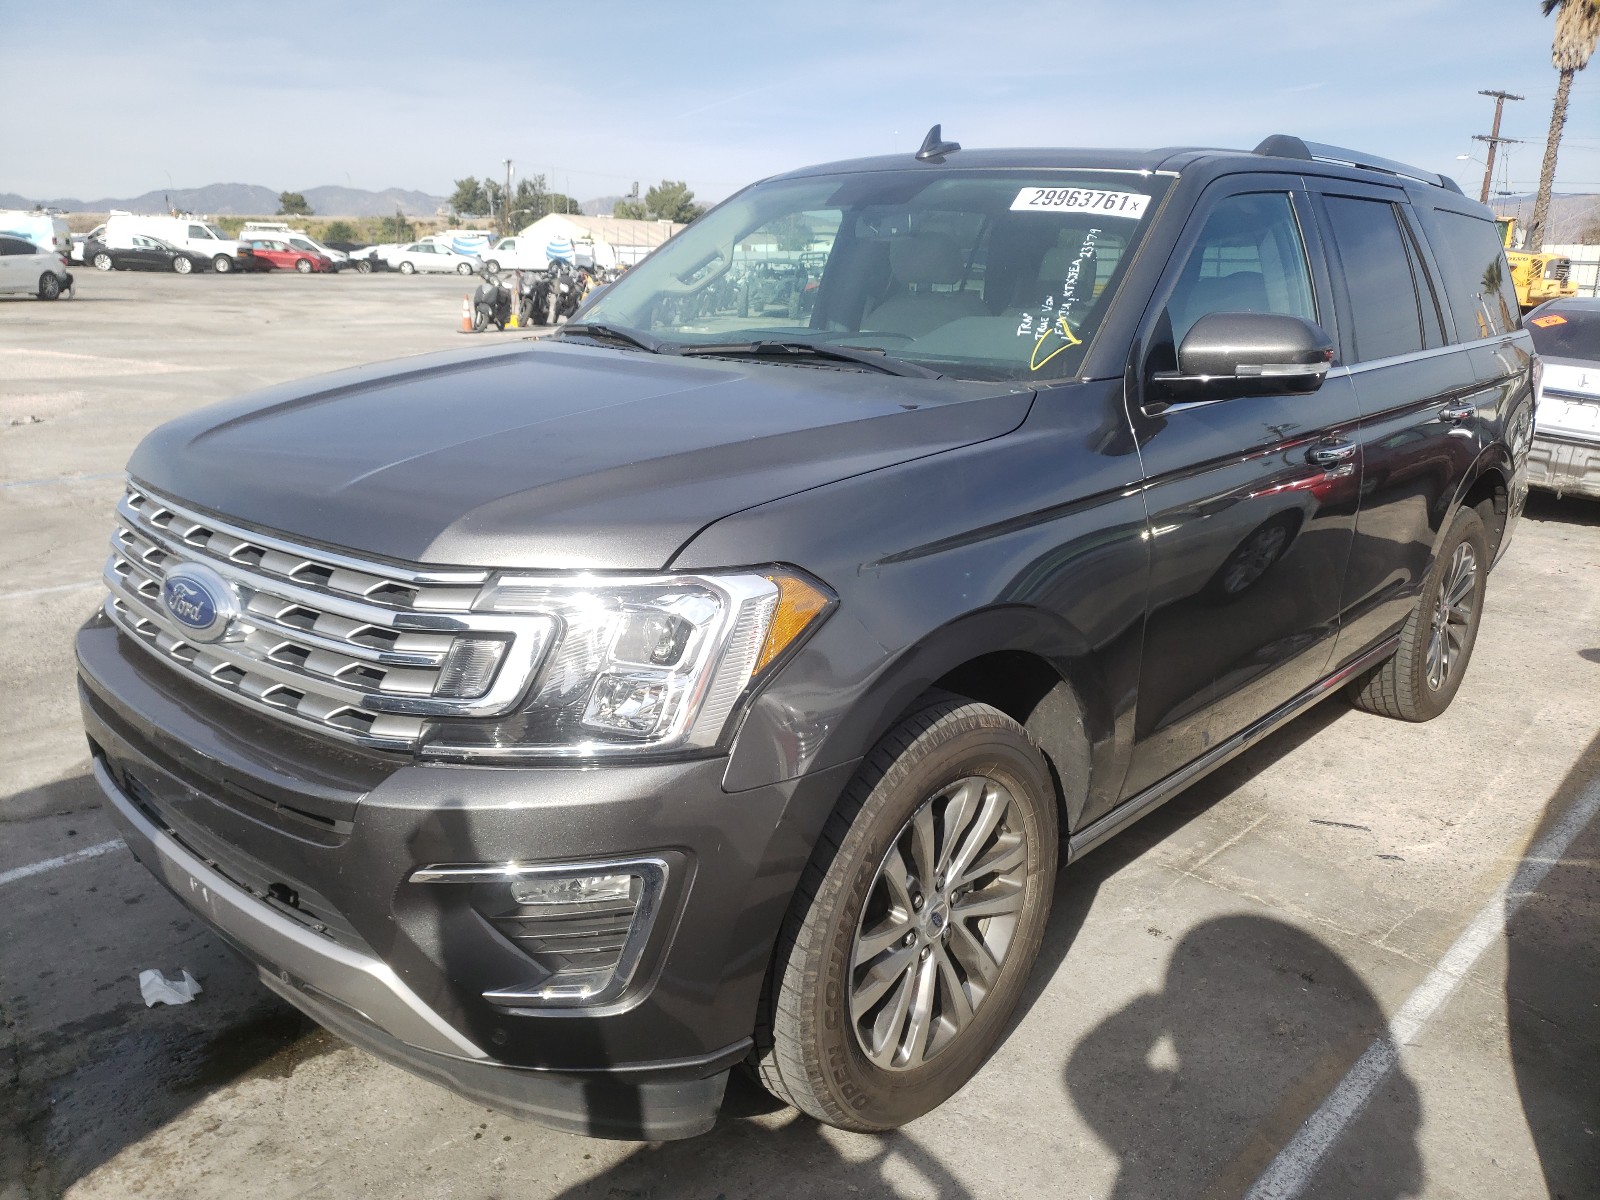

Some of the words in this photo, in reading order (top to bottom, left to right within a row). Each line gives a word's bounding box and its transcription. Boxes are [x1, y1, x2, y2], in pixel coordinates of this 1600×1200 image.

[1029, 189, 1129, 211] 29963761
[168, 582, 205, 622] Ford
[823, 837, 880, 1031] COUNTRY
[827, 1044, 870, 1112] OPEN
